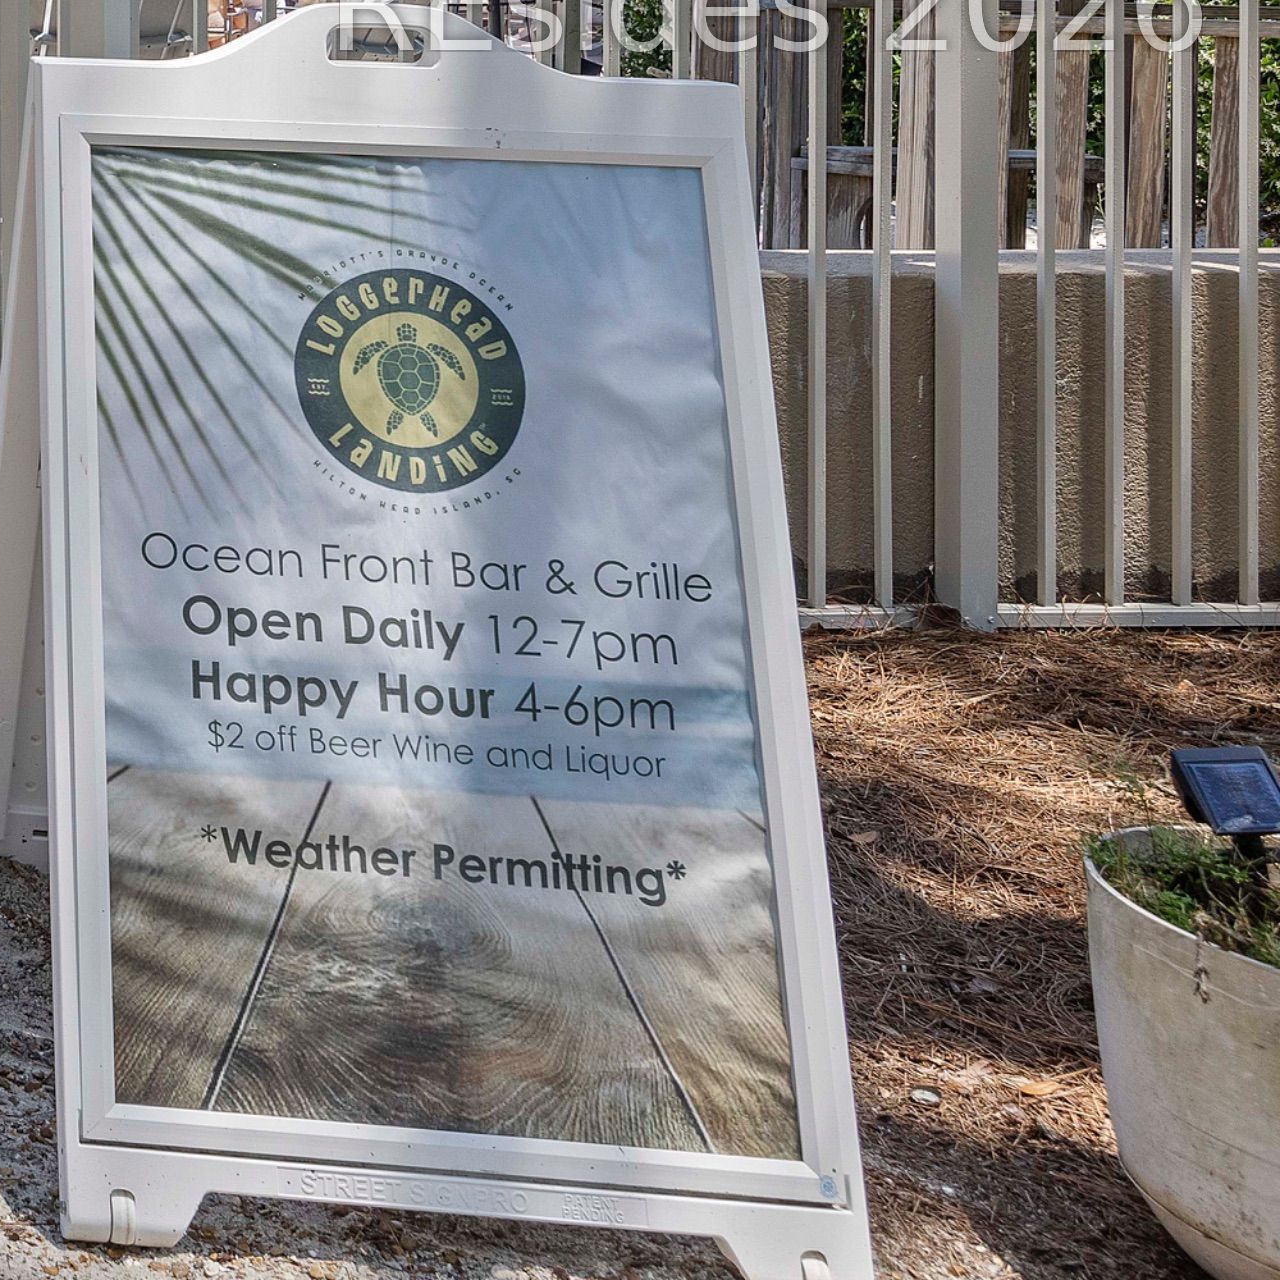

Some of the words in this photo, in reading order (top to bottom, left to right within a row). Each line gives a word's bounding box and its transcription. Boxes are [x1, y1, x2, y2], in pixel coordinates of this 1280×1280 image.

[396, 249, 460, 271] GRANDE
[468, 271, 515, 312] OCEAN
[313, 459, 368, 501] HILTON
[379, 500, 421, 515] HEAD
[140, 531, 304, 578] Ocean
[320, 543, 434, 587] Front
[451, 551, 528, 592] Bar
[544, 558, 578, 597] &
[593, 559, 714, 604] Grille
[182, 594, 324, 646] Open
[342, 604, 466, 661] Daily
[486, 614, 679, 671] 12-7pm
[190, 659, 359, 720] Happy
[378, 672, 496, 720] Hour
[513, 681, 676, 737] 4-6pm
[206, 719, 245, 754] $2
[255, 722, 298, 753] off
[309, 727, 383, 759] Beer
[392, 732, 474, 766] Wine
[486, 741, 553, 772] and
[566, 745, 667, 781] Liquor
[300, 1172, 403, 1204] STREET
[561, 1205, 625, 1225] PENDING
[563, 1192, 620, 1212] PATENT
